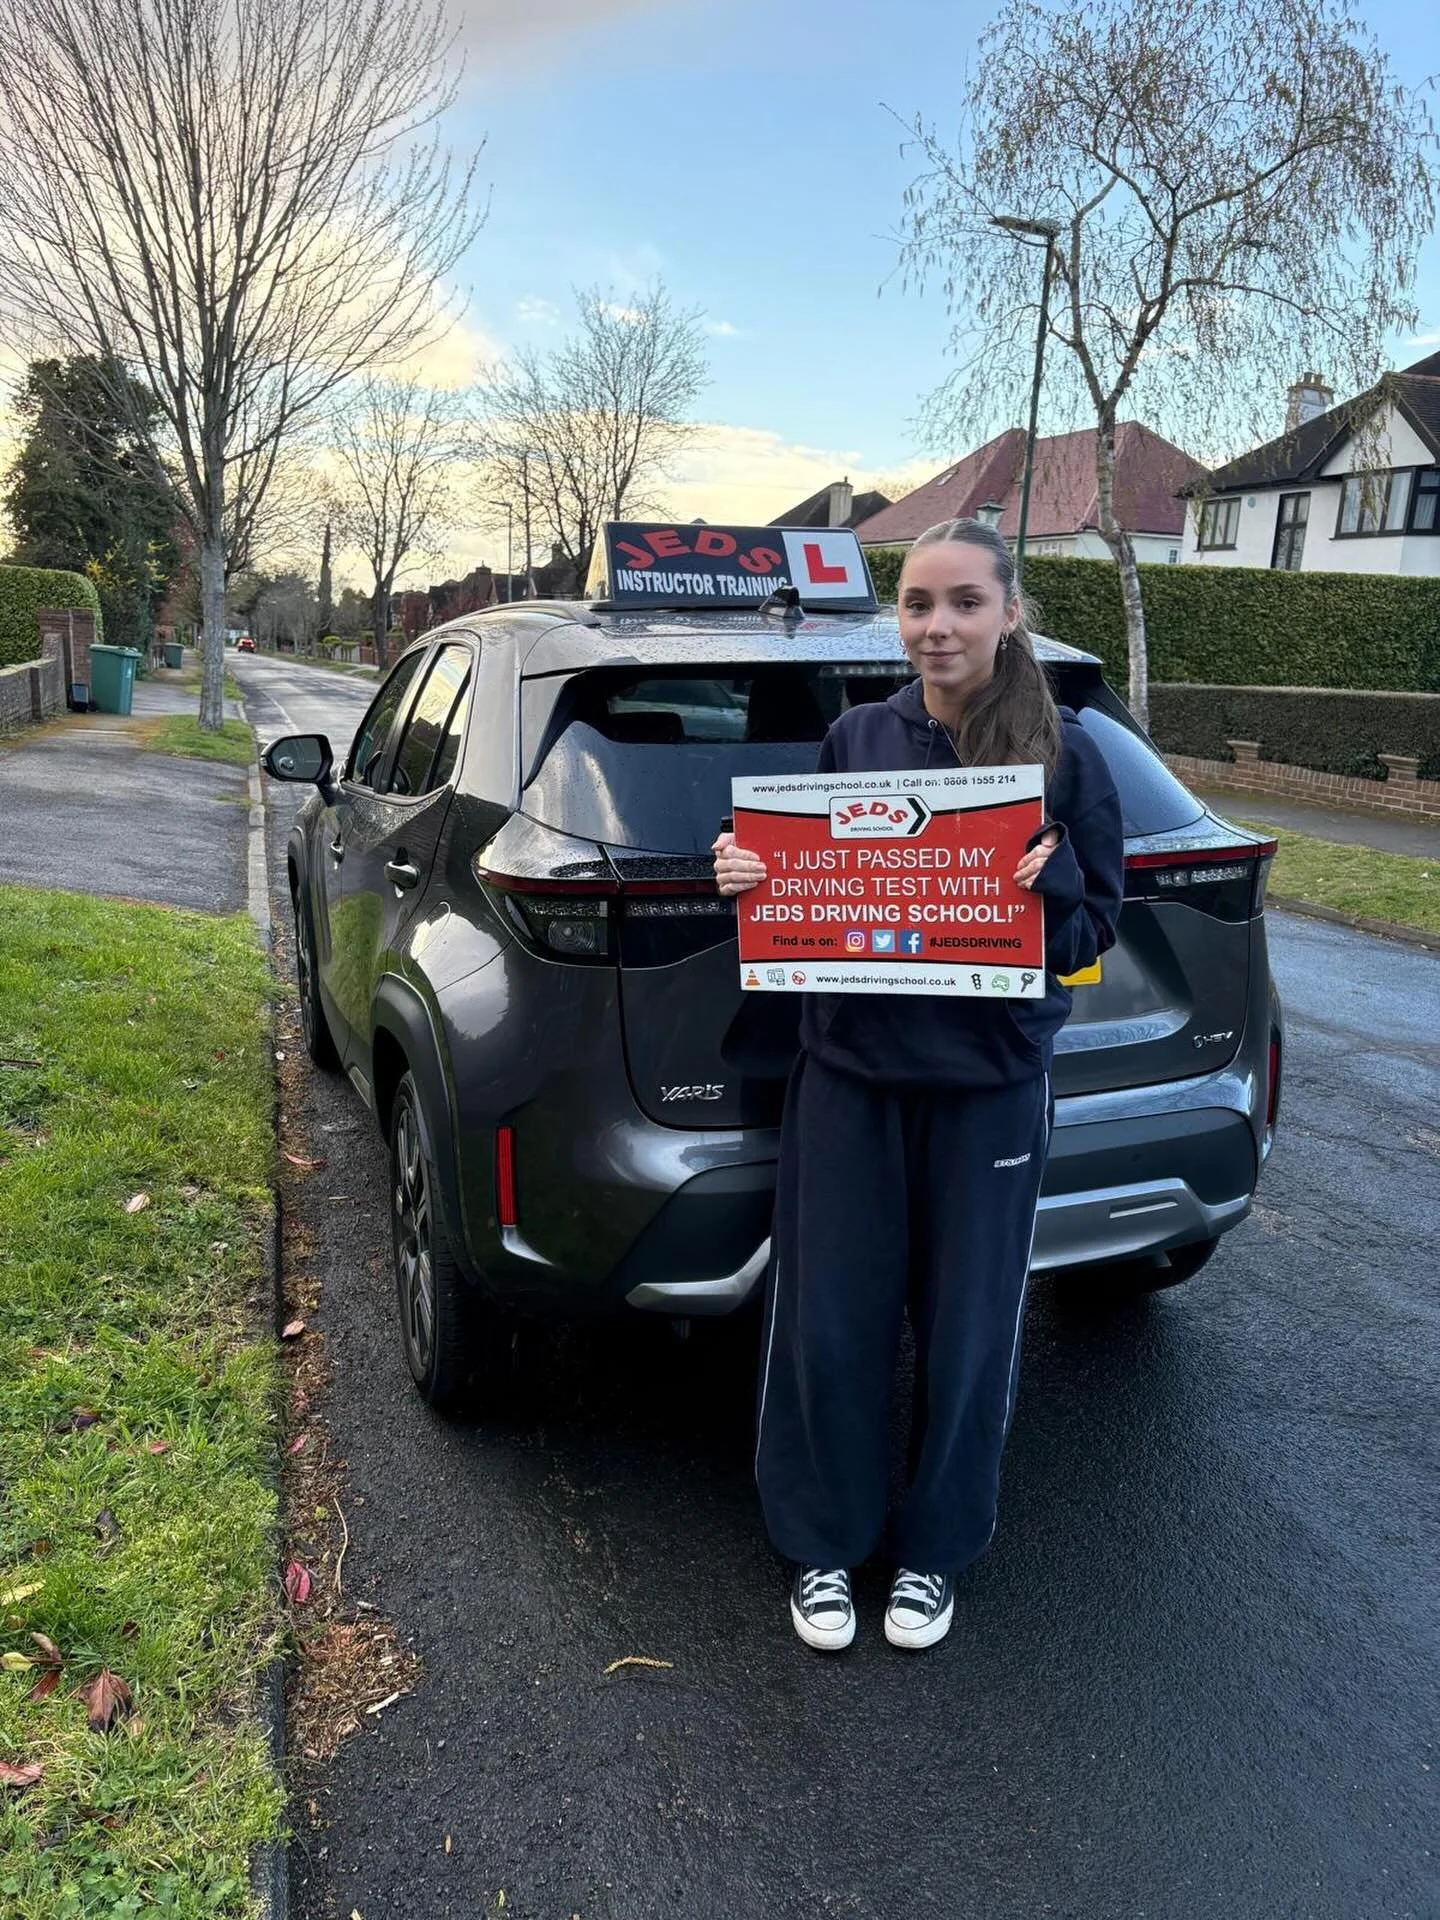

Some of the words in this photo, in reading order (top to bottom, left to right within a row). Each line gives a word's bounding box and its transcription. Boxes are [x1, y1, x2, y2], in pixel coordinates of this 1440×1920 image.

[616, 529, 782, 573] JEDS
[803, 543, 848, 583] L
[616, 569, 715, 595] INSTRUCTOR
[752, 780, 892, 794] www.jedsdrivingschool.co.uk
[903, 778, 921, 787] Call
[925, 778, 941, 787] on:
[998, 774, 1016, 784] 214
[835, 801, 909, 825] JEDS
[794, 850, 850, 870] JUST
[857, 848, 951, 869] PASSED
[960, 848, 995, 868] MY
[771, 878, 865, 896] DRIVING
[871, 877, 931, 896] TEST
[938, 877, 1000, 896] WITH
[750, 904, 804, 922] JEDS
[811, 904, 901, 922] DRIVING
[773, 935, 798, 946] Find
[802, 937, 815, 946] us
[819, 937, 838, 946] on:
[930, 937, 1022, 949] #JEDSDRIVING
[816, 974, 956, 987] www.jedsdrivingschool.co.uk
[660, 1084, 725, 1101] YARIS
